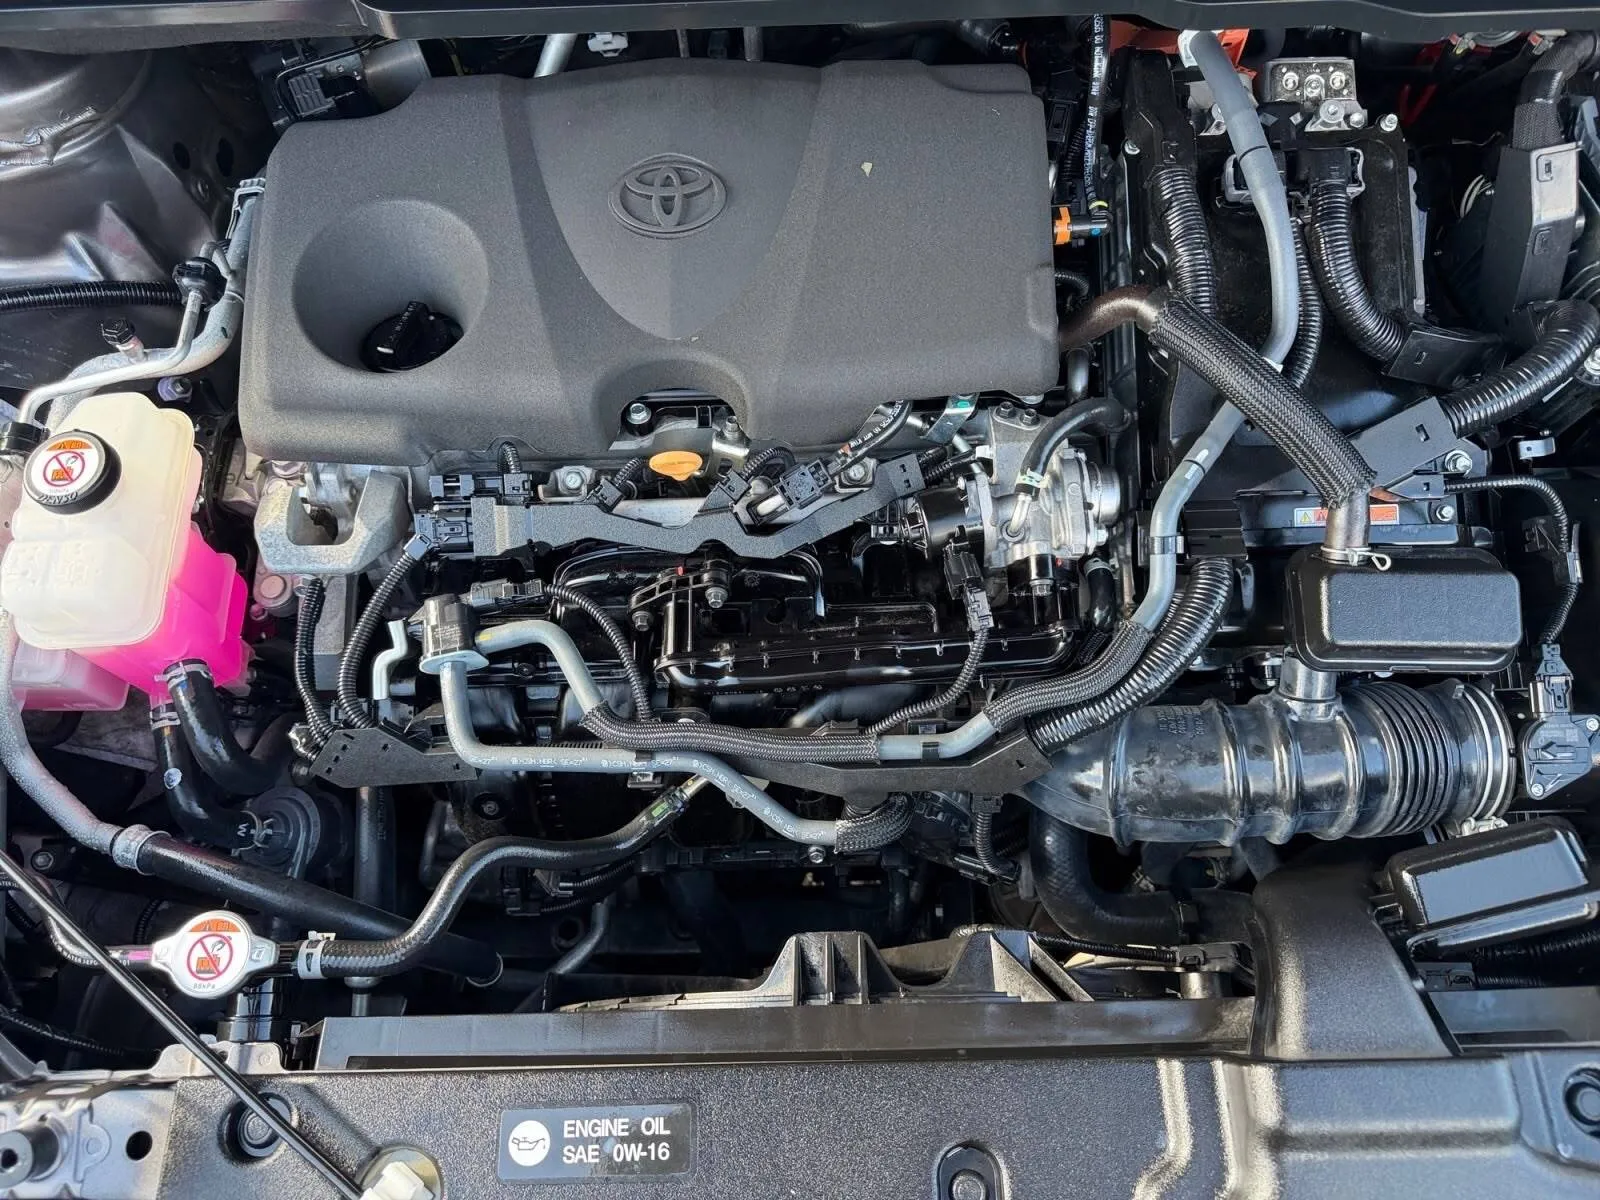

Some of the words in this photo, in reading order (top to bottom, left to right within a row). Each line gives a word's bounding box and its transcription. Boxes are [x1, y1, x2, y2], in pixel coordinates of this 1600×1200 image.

[37, 491, 78, 504] DENSO
[563, 1118, 629, 1138] ENGINE
[641, 1117, 670, 1136] OIL
[562, 1145, 599, 1164] SAE
[613, 1142, 670, 1162] 0W-16
